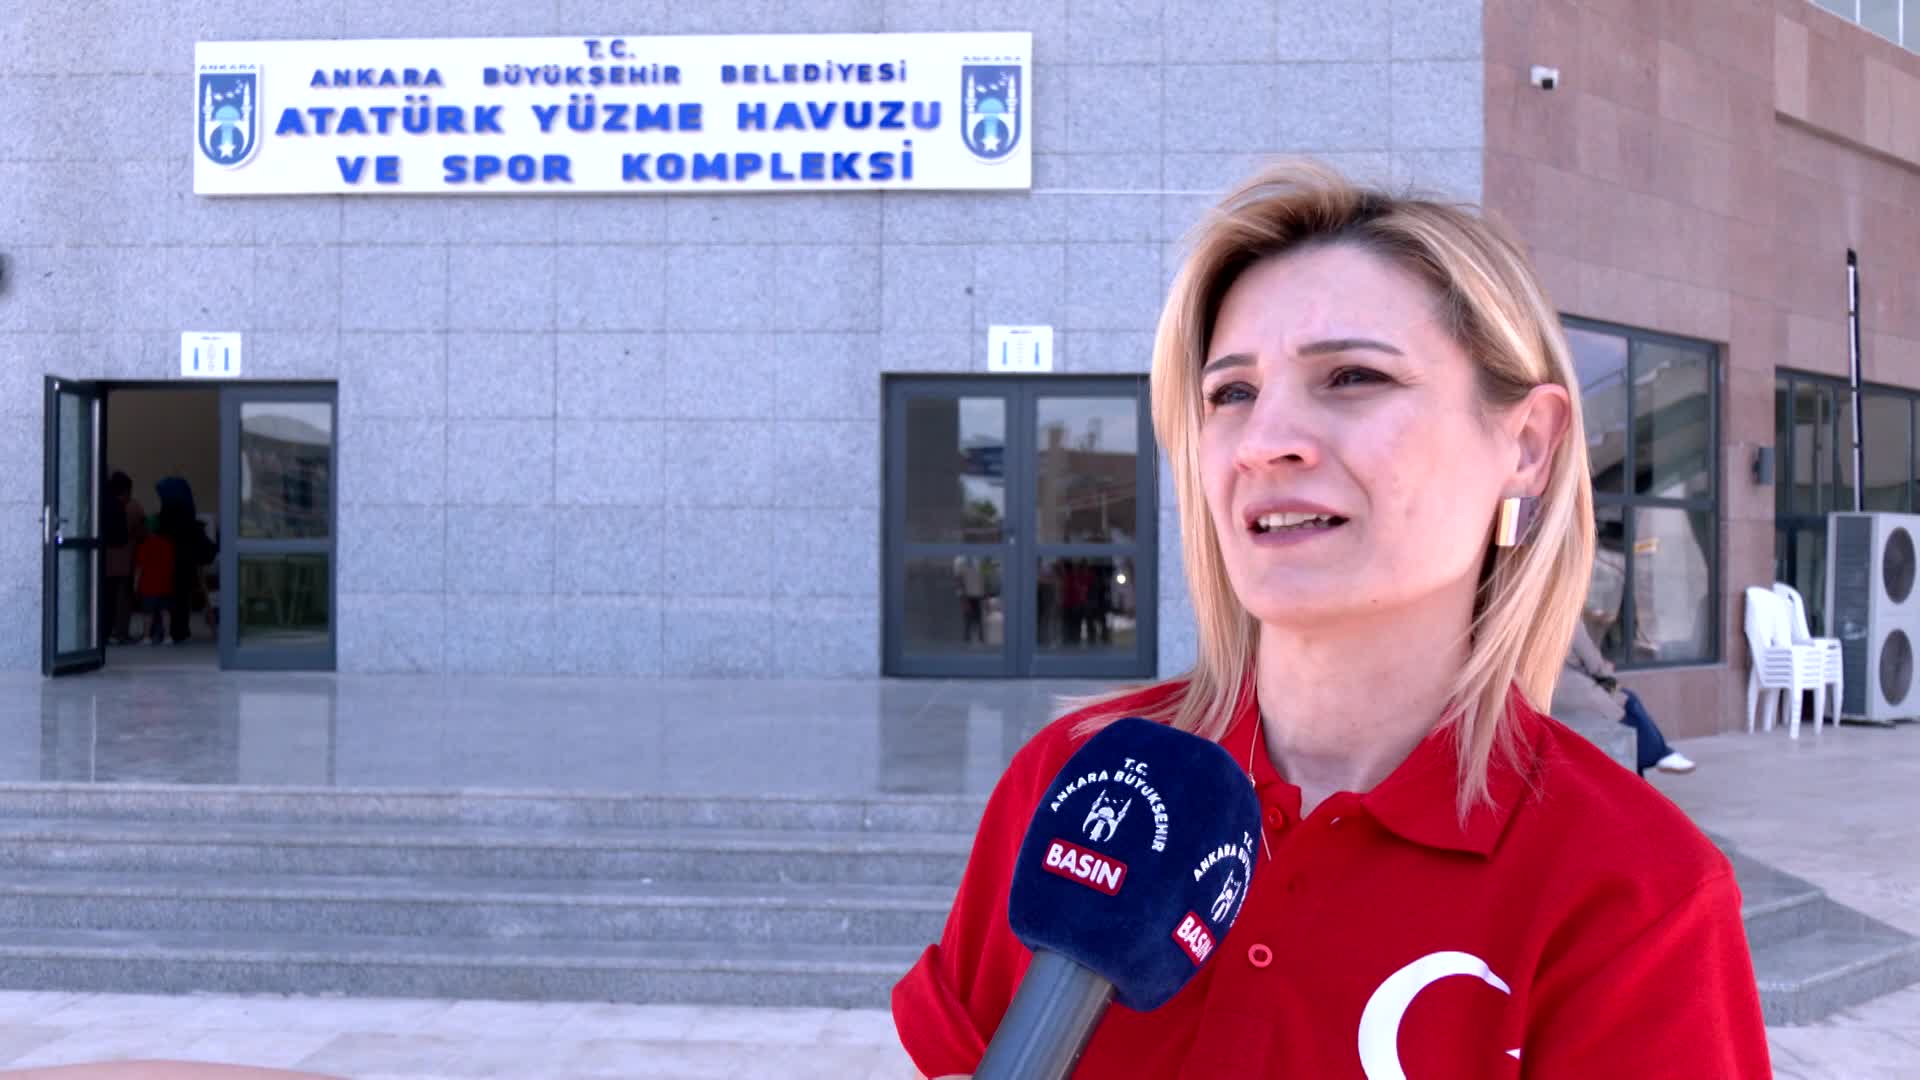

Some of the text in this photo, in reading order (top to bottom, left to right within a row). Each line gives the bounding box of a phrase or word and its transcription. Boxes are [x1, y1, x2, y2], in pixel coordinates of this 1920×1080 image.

[310, 68, 443, 88] ANKARA
[275, 92, 942, 136] ATATÜRK YÜZME HAVUZU
[336, 140, 914, 184] VE SPOR KOMPLEKSİ
[1050, 769, 1109, 812] ANKARA
[1045, 842, 1122, 891] BASIN
[1193, 843, 1238, 882] ANKARA
